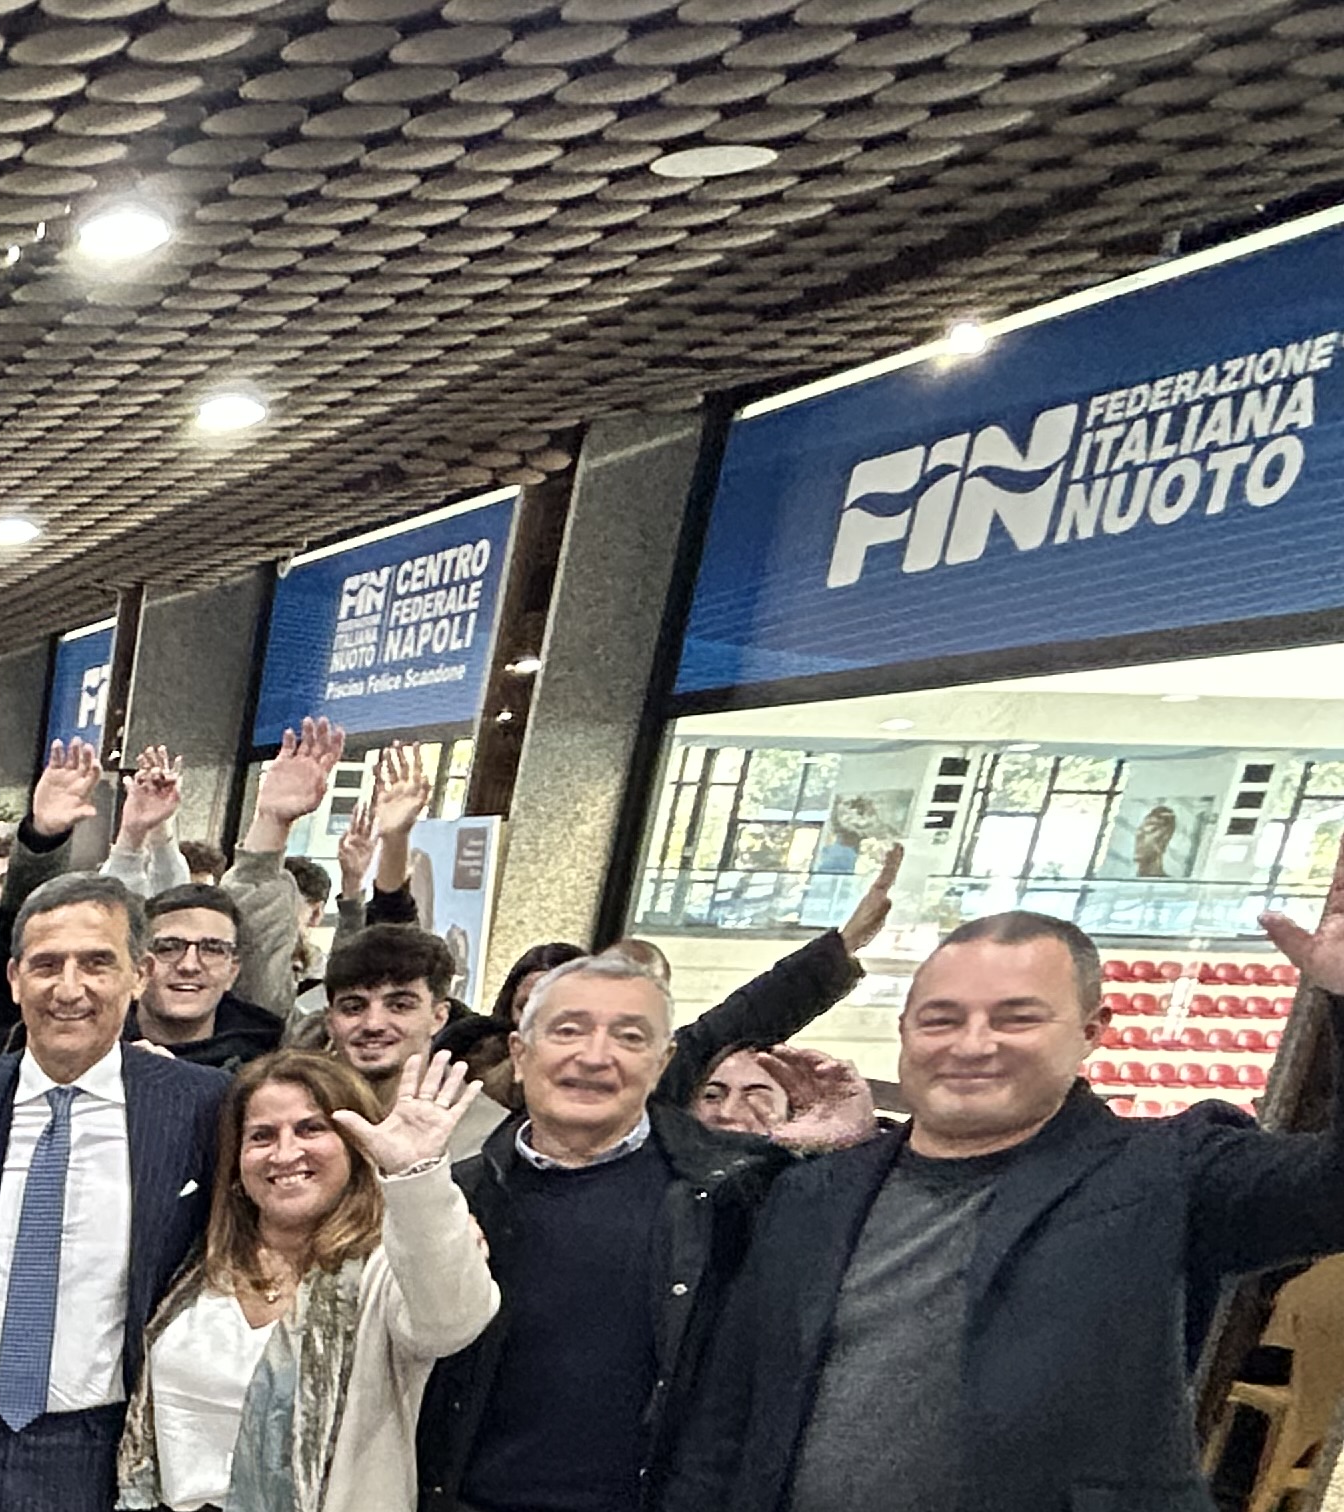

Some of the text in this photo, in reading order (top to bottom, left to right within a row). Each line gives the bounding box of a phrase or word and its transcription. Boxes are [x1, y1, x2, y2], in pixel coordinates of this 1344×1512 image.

[1086, 332, 1338, 428] FEDERAZIONE
[1070, 376, 1316, 479] ITALIANA
[826, 403, 1079, 589] FIN
[1054, 435, 1306, 545] NUOTO
[338, 566, 393, 620] FIN
[396, 538, 491, 596] CENTRO
[389, 579, 483, 628] FEDERALE
[329, 644, 377, 674] NUOTO
[383, 612, 478, 664] NAPOLI
[77, 664, 111, 728] FI
[325, 679, 364, 701] Piscina
[367, 670, 402, 695] Felice
